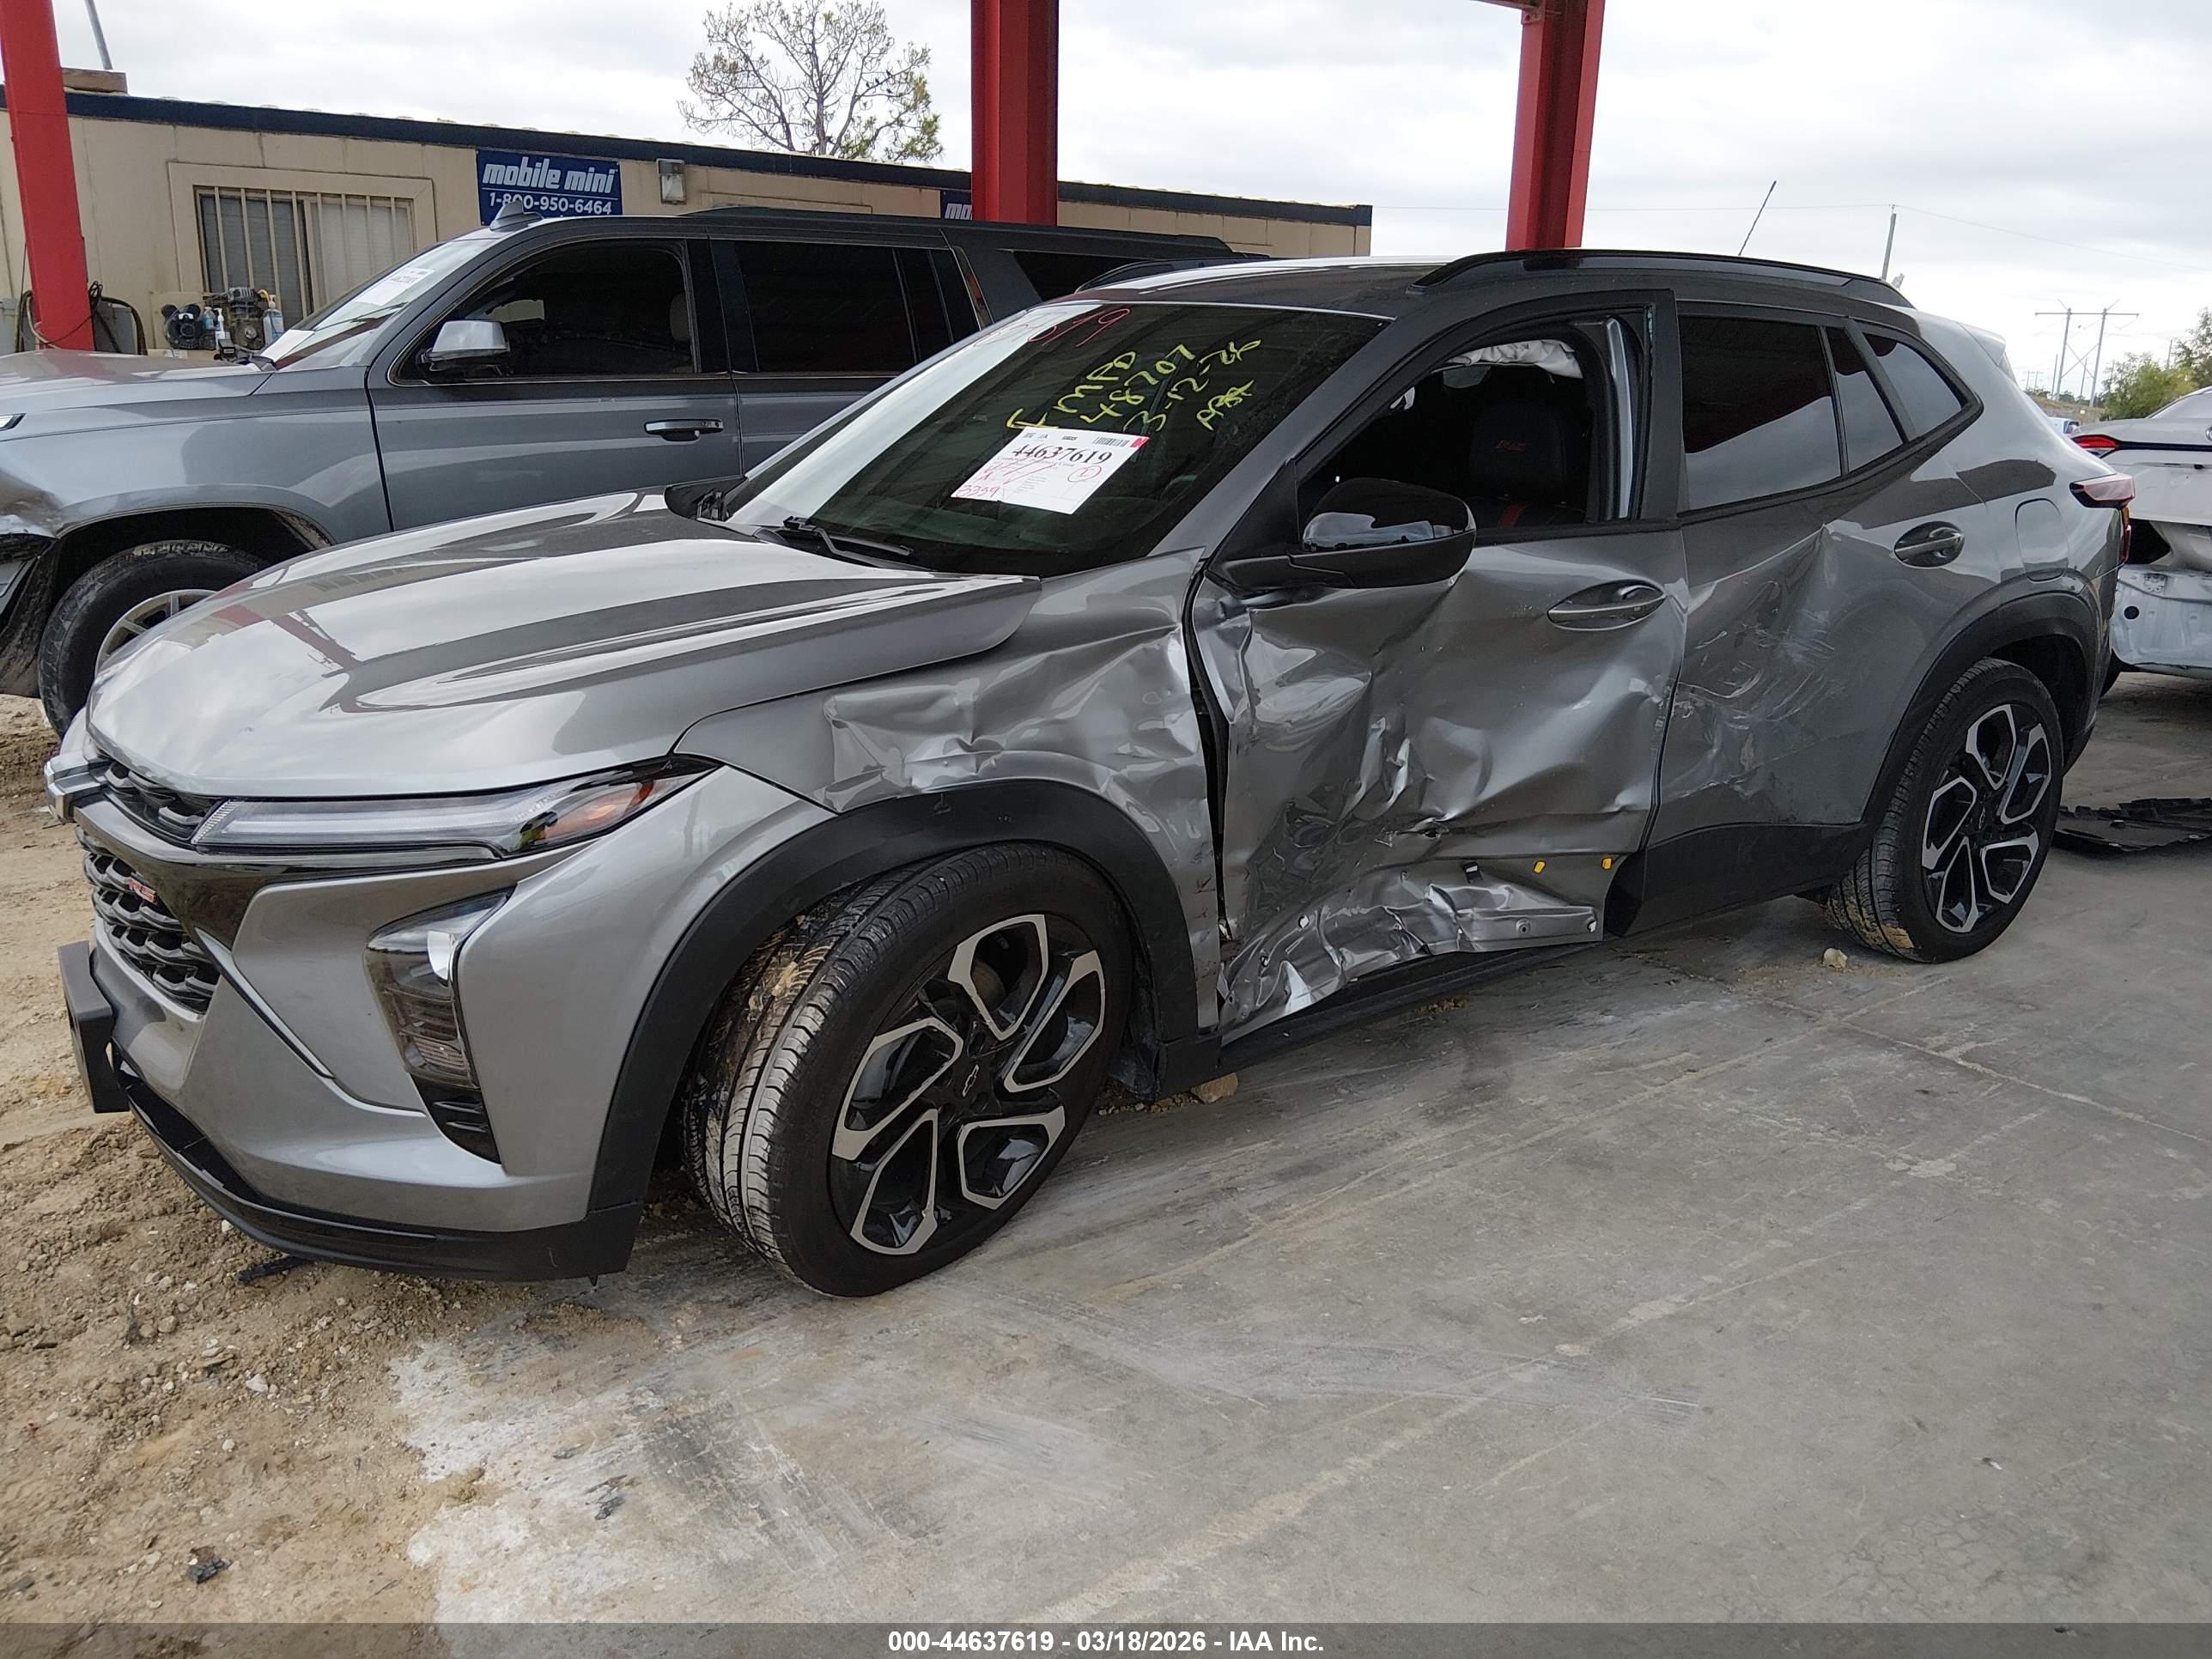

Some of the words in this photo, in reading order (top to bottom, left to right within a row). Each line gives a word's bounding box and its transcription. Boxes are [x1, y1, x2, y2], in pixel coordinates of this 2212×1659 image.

[483, 157, 561, 188] mobile
[563, 167, 616, 193] mini
[945, 203, 972, 220] mo
[1012, 443, 1113, 465] 44637619
[128, 878, 155, 902] RS
